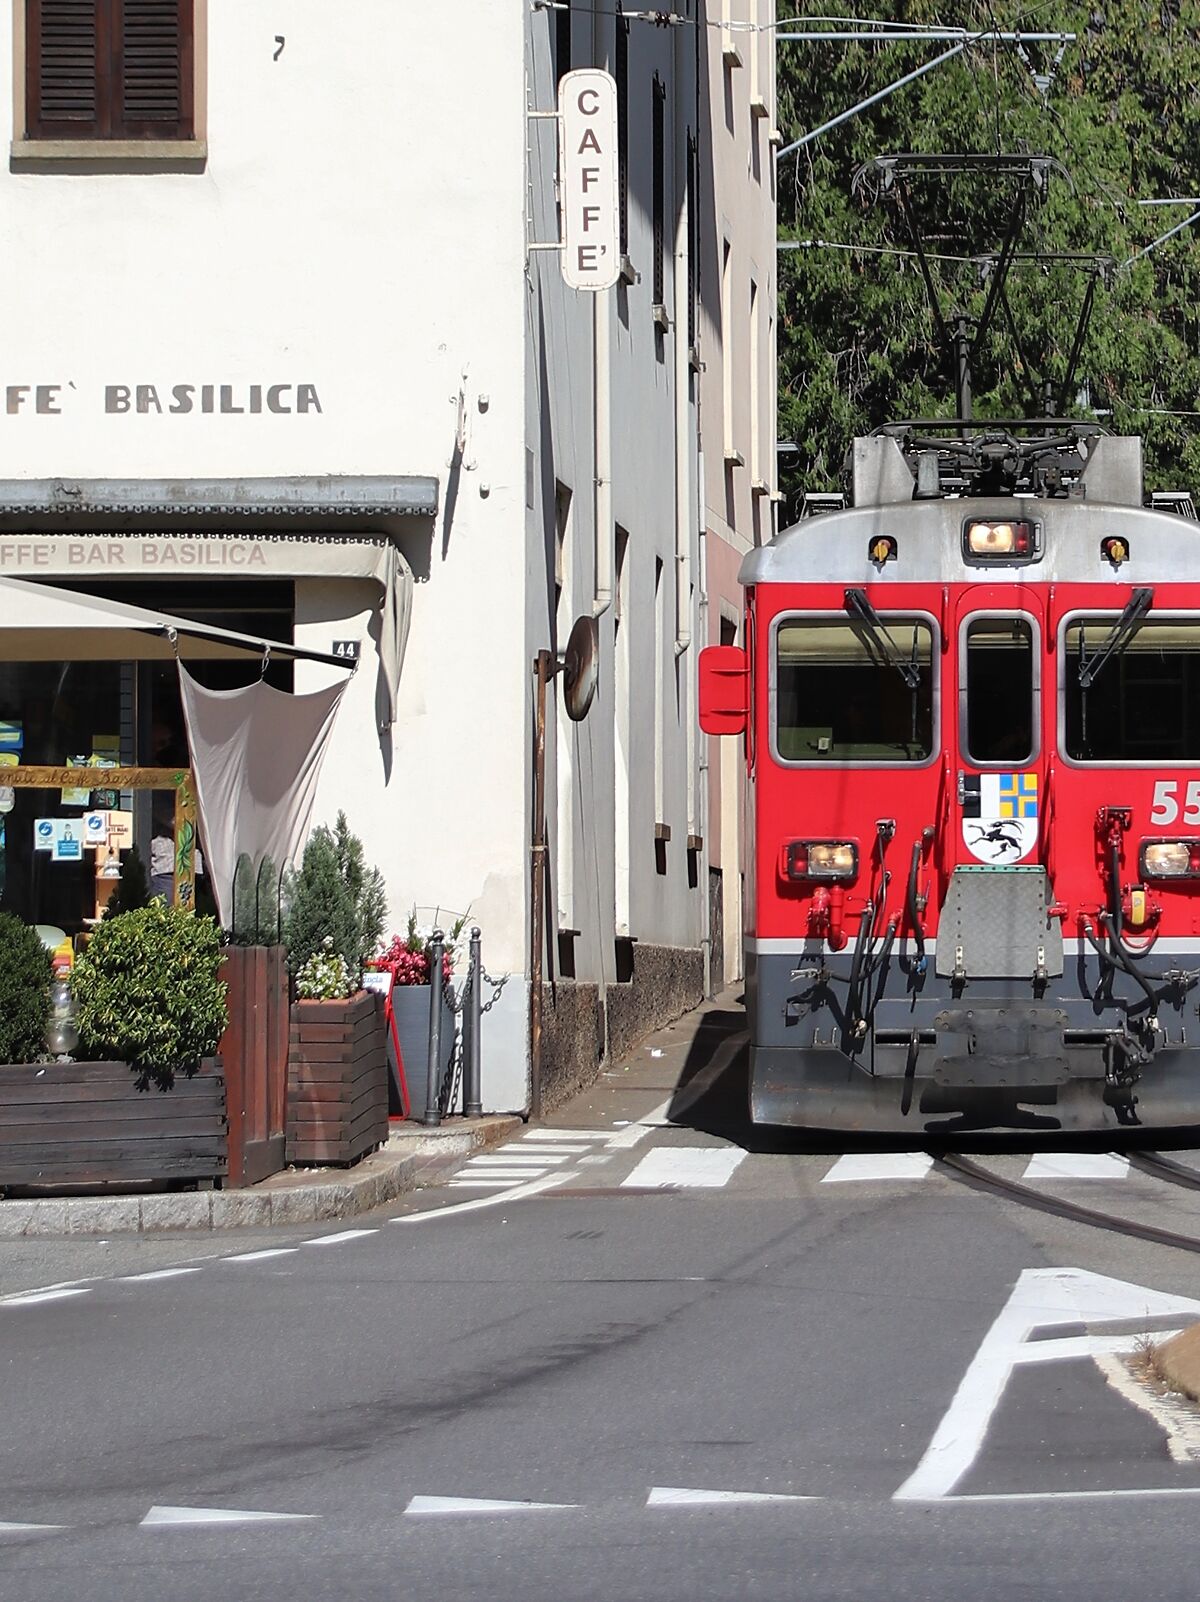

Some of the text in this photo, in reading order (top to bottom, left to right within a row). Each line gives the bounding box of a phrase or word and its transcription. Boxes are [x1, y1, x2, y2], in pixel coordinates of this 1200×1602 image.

[577, 89, 606, 271] CAFFE'
[105, 384, 322, 414] BASILICA
[68, 544, 125, 565] BAR
[141, 543, 266, 565] BASILICA
[337, 643, 354, 657] 44
